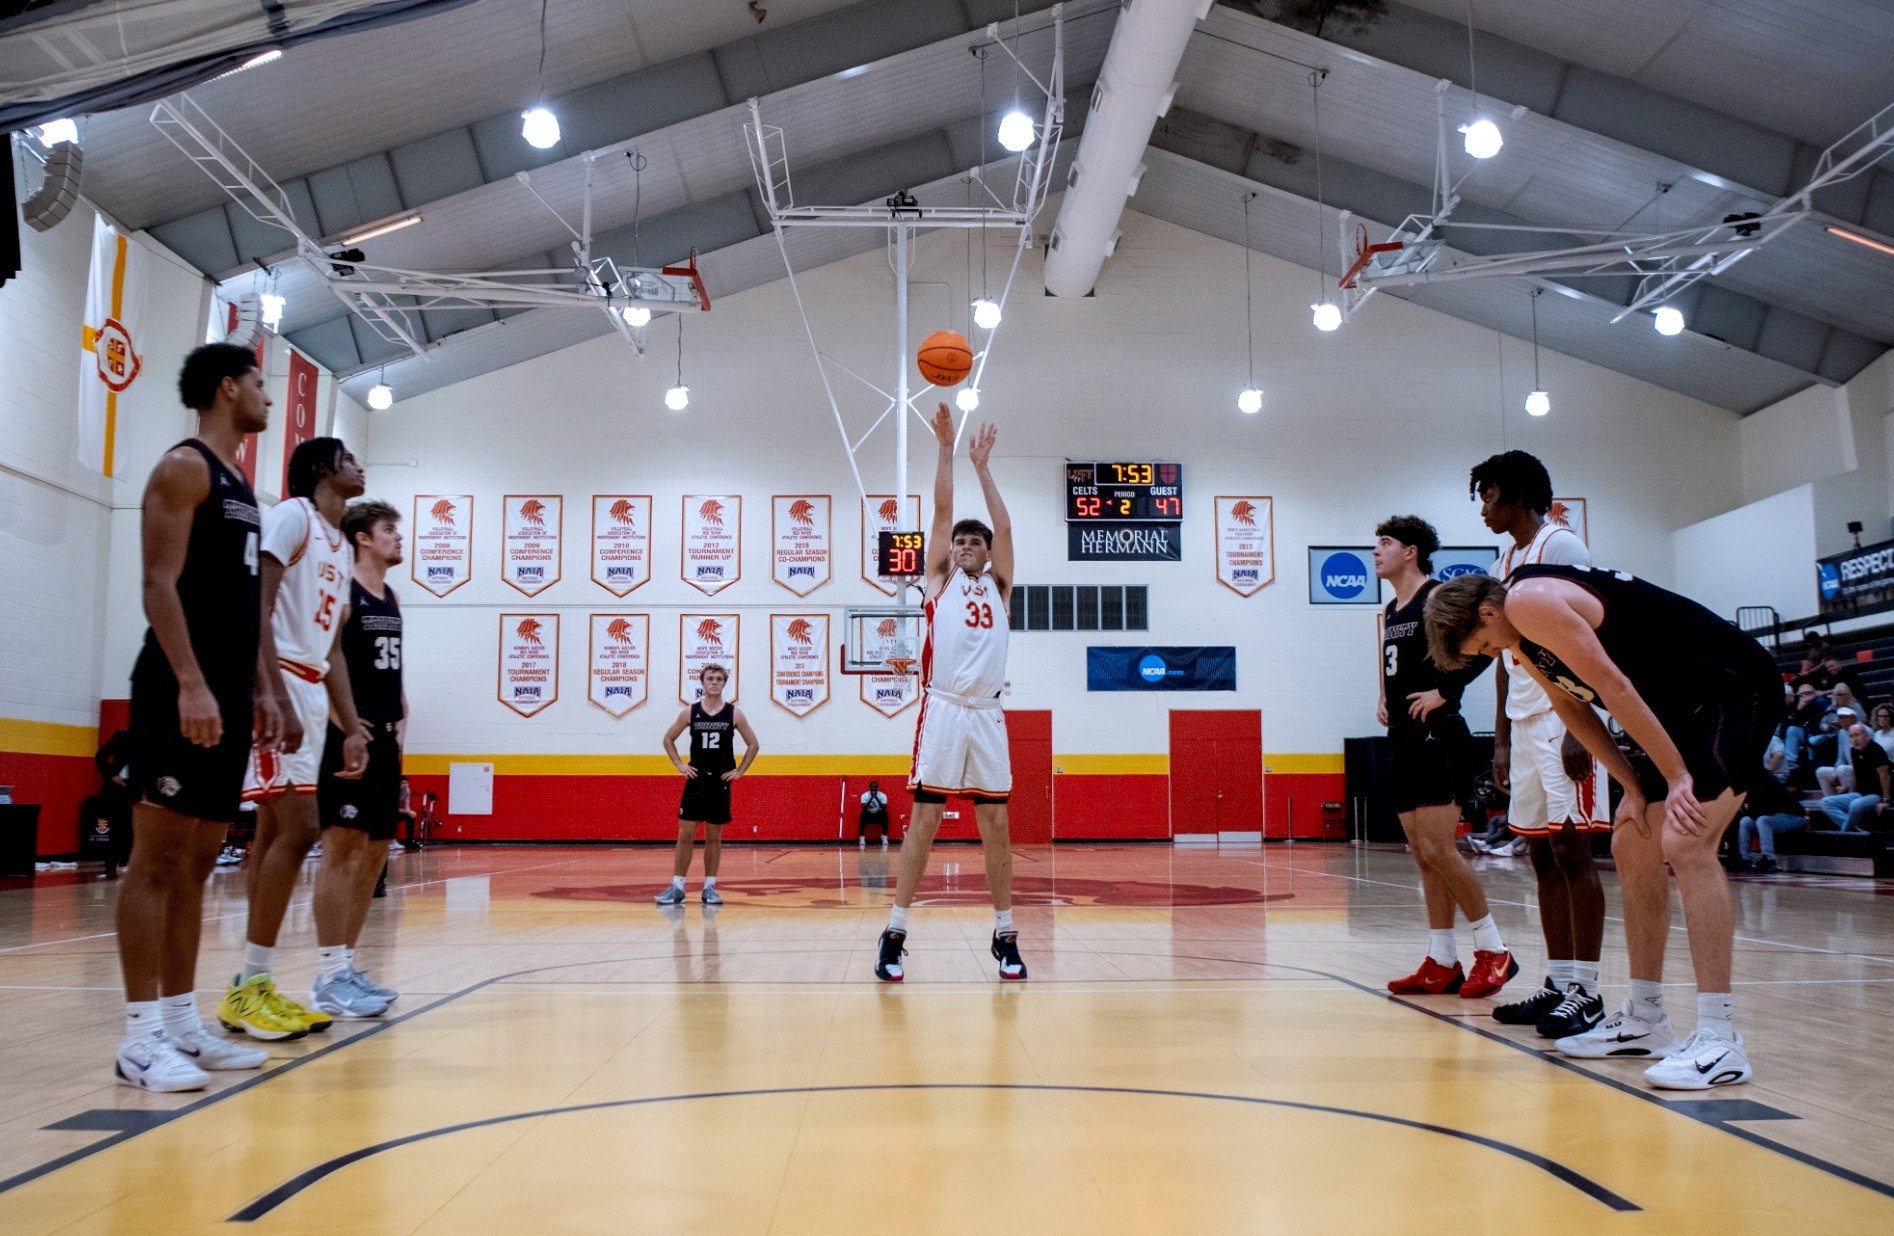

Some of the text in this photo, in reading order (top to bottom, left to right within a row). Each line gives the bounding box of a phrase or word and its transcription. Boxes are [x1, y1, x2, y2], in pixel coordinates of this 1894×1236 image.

[1111, 464, 1152, 483] 7:53
[1072, 486, 1098, 495] CELTS
[1150, 486, 1178, 495] GUEST
[1076, 497, 1100, 516] 52
[1120, 499, 1131, 515] 2
[1155, 497, 1180, 515] 47
[892, 535, 922, 549] 7:53
[1081, 529, 1168, 544] MEMORIAL
[243, 531, 259, 576] 4
[1081, 541, 1167, 554] HERMANN
[890, 549, 916, 572] 30
[427, 566, 454, 578] NAIA
[517, 566, 544, 578] NAIA
[607, 566, 634, 578] NAIA
[696, 566, 724, 578] NAIA
[788, 566, 815, 578] NAIA
[1325, 575, 1366, 588] NCAA
[965, 601, 993, 629] 33
[373, 636, 400, 670] 35
[1385, 644, 1398, 677] 3
[514, 686, 541, 698] NAIA
[605, 686, 632, 698] NAIA
[786, 689, 813, 701] NAIA
[876, 689, 903, 701] NAIA
[701, 732, 720, 749] 12
